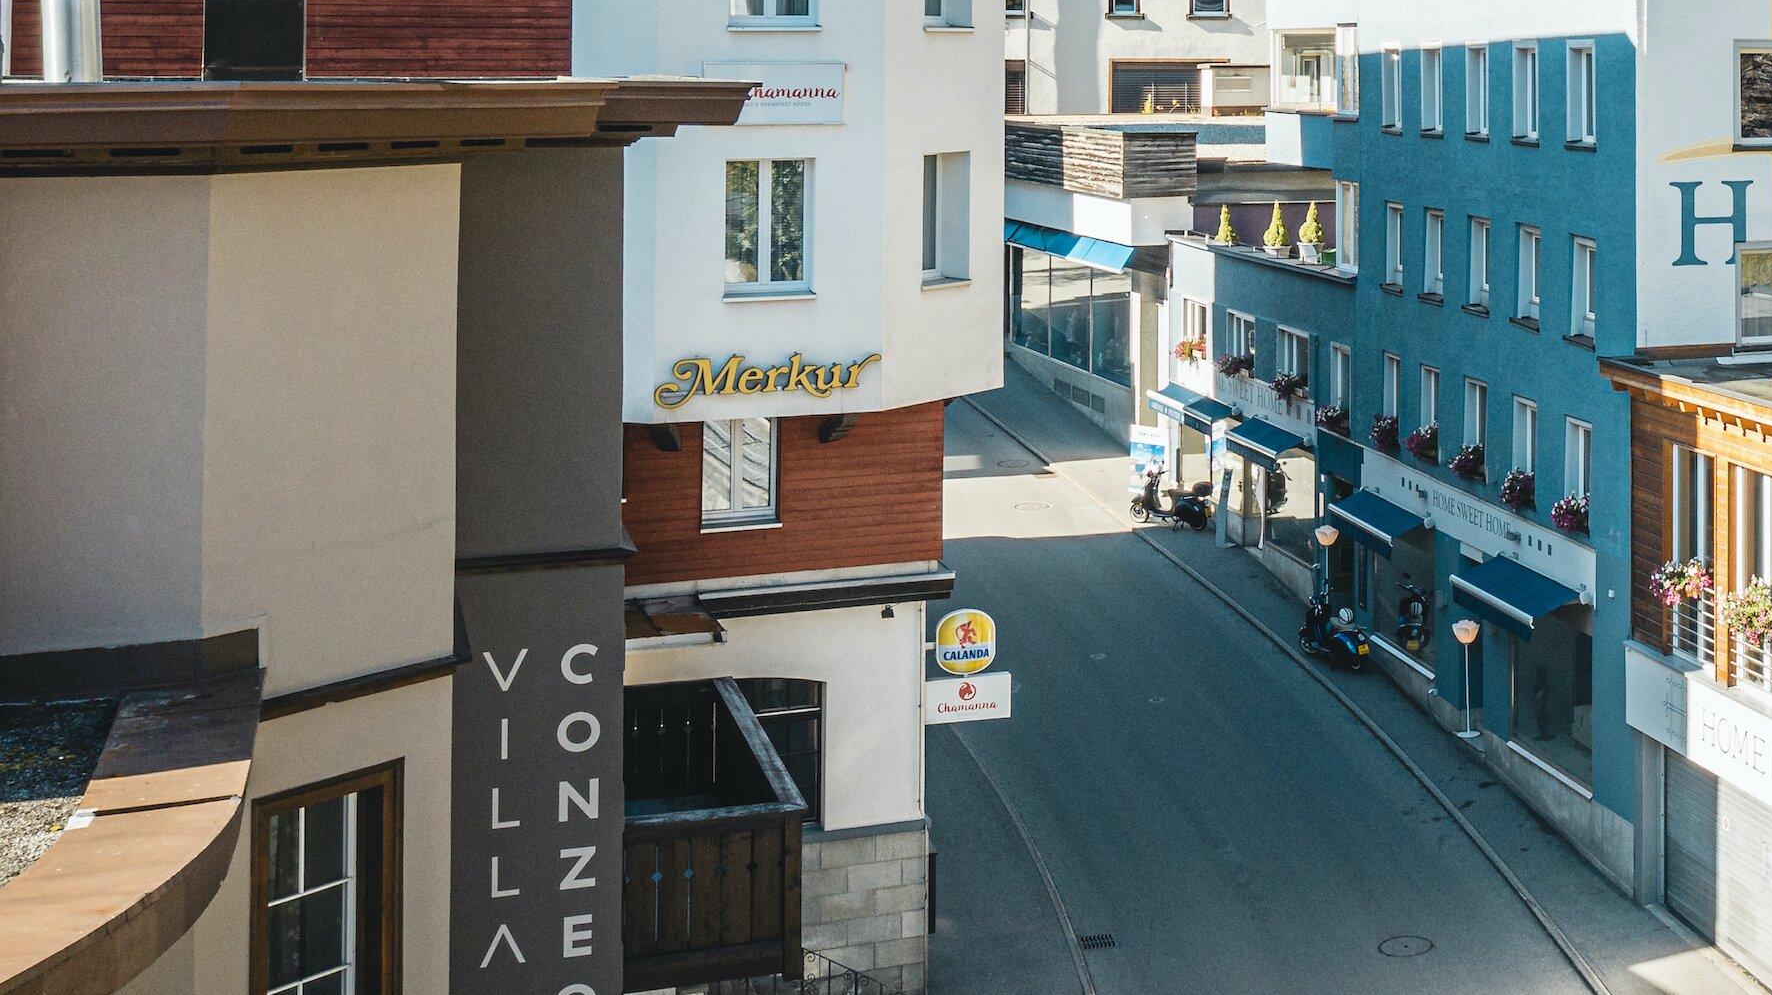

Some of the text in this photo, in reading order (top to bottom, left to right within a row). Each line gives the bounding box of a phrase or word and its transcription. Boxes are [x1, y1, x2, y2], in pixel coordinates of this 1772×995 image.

[750, 85, 840, 99] hamanna
[654, 351, 882, 410] Merkur
[1432, 489, 1456, 516] HOME
[1456, 501, 1485, 528] SWEET
[943, 648, 990, 661] CALANDA
[937, 701, 998, 714] Chamanna
[1701, 707, 1766, 775] HOME
[479, 648, 529, 969] VILLA
[556, 642, 602, 995] CONZE
